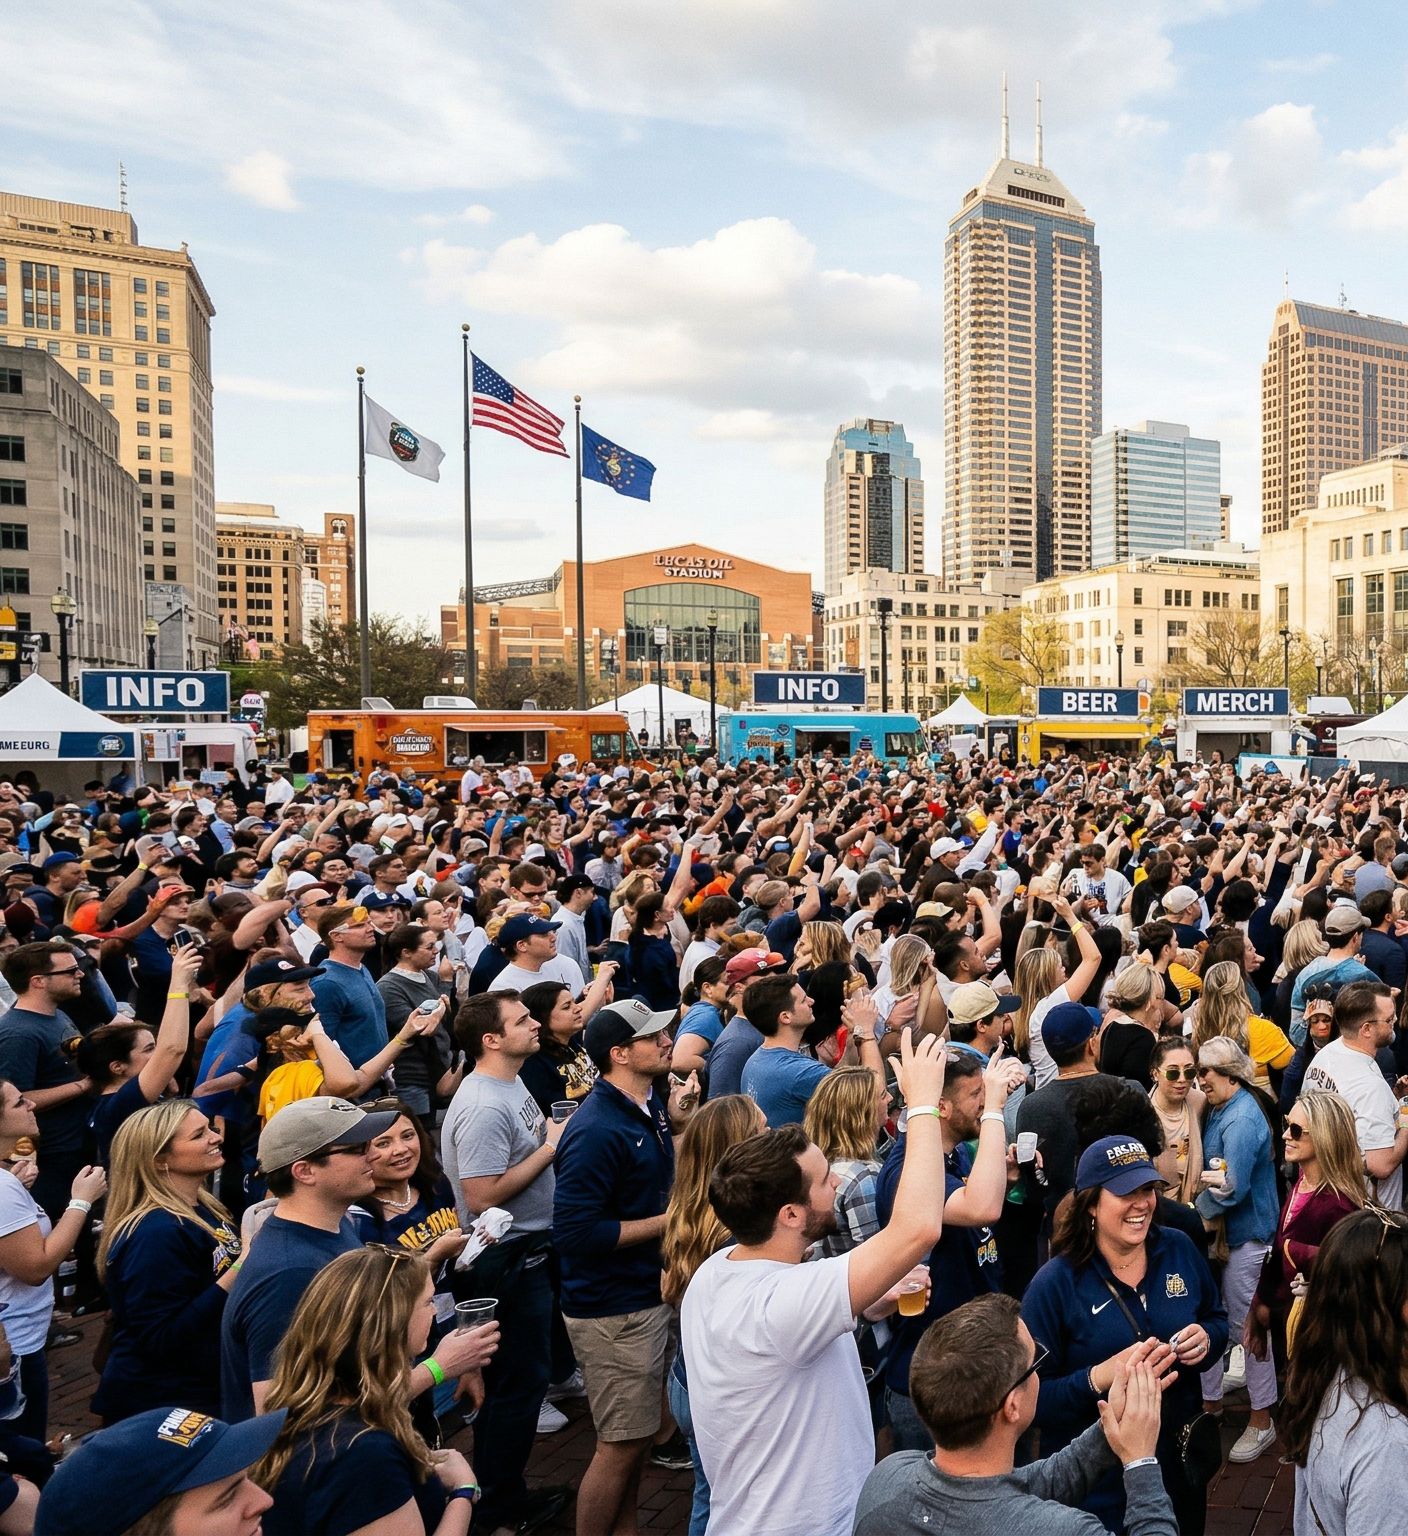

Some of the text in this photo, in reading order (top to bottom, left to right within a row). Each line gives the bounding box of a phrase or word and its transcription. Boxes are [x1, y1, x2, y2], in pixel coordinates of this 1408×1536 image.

[664, 567, 723, 579] STADIUM
[708, 558, 733, 569] OIL
[106, 676, 206, 707] INFO
[778, 677, 840, 701] INFO
[1062, 692, 1118, 712] BEER
[1196, 692, 1275, 712] MERCH
